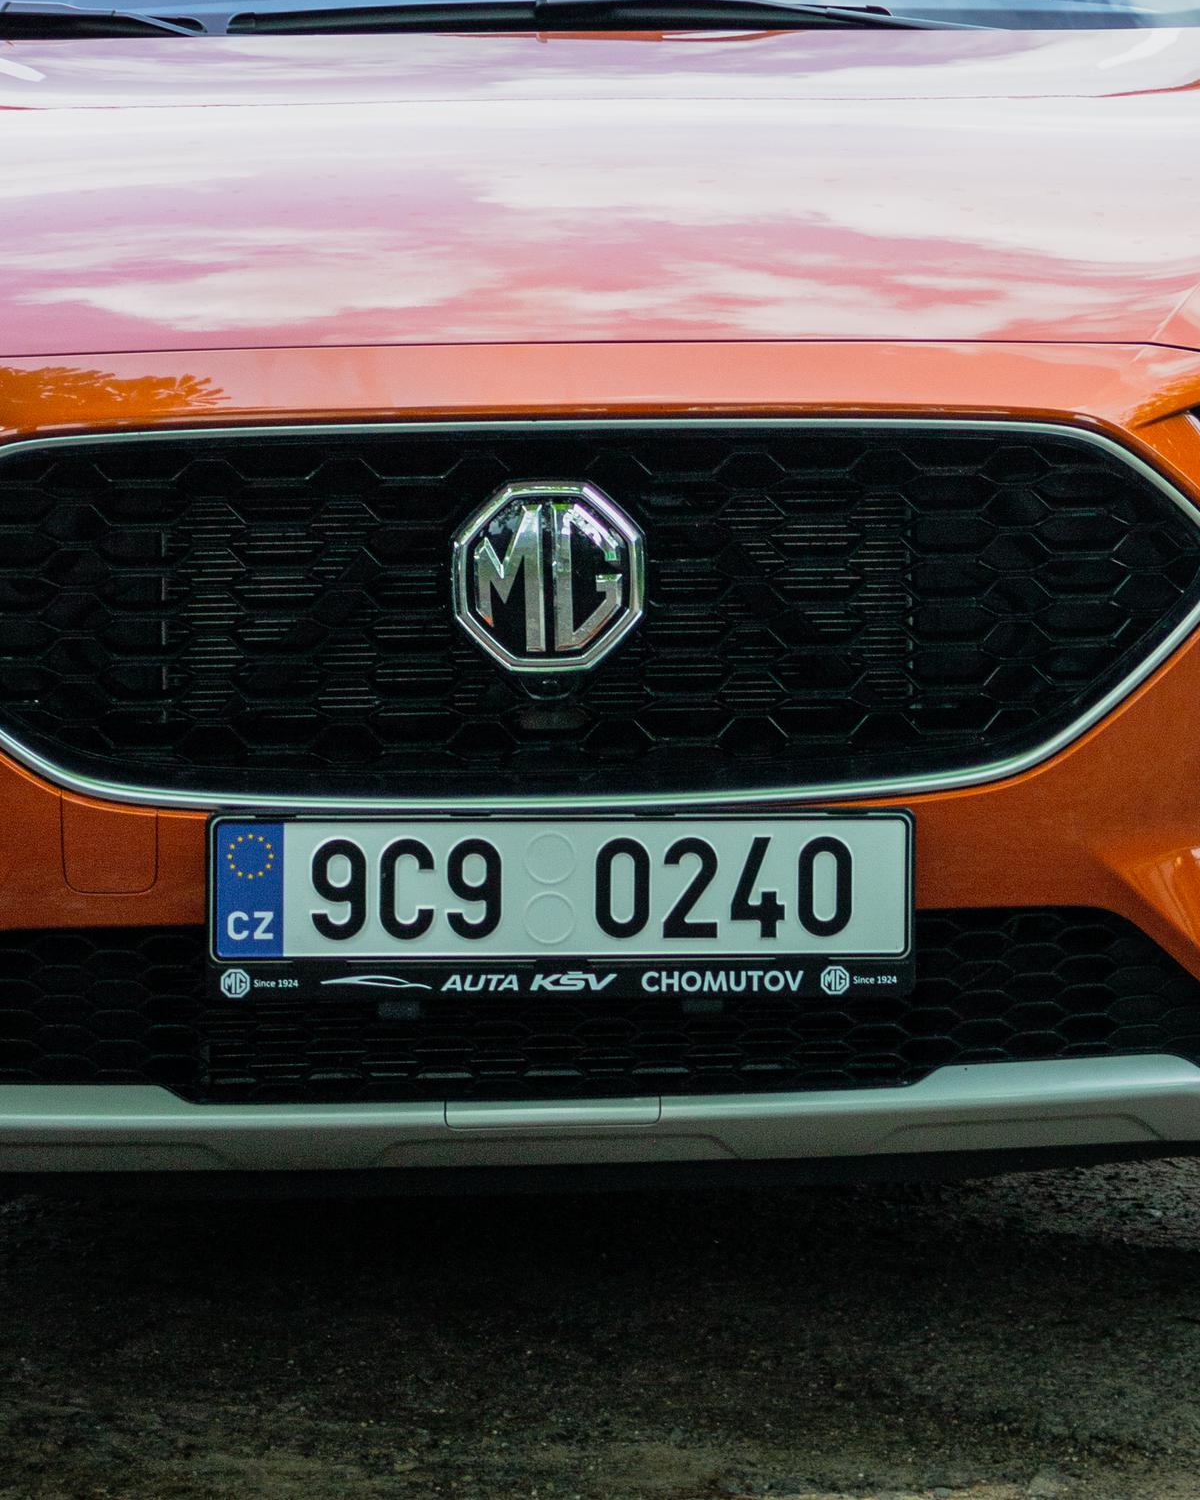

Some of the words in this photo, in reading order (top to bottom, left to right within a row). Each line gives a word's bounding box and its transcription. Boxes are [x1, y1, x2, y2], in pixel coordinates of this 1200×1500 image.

[472, 502, 624, 653] MG
[310, 837, 502, 941] 9C9
[595, 835, 853, 939] 0240
[227, 910, 275, 941] CZ
[223, 971, 248, 995] MG
[253, 978, 276, 988] Since
[278, 978, 299, 988] 1924
[440, 974, 519, 992] AUTA
[641, 970, 804, 993] CHOMUTOV
[823, 968, 847, 992] MG
[853, 975, 875, 985] Since
[877, 975, 898, 985] 1924
